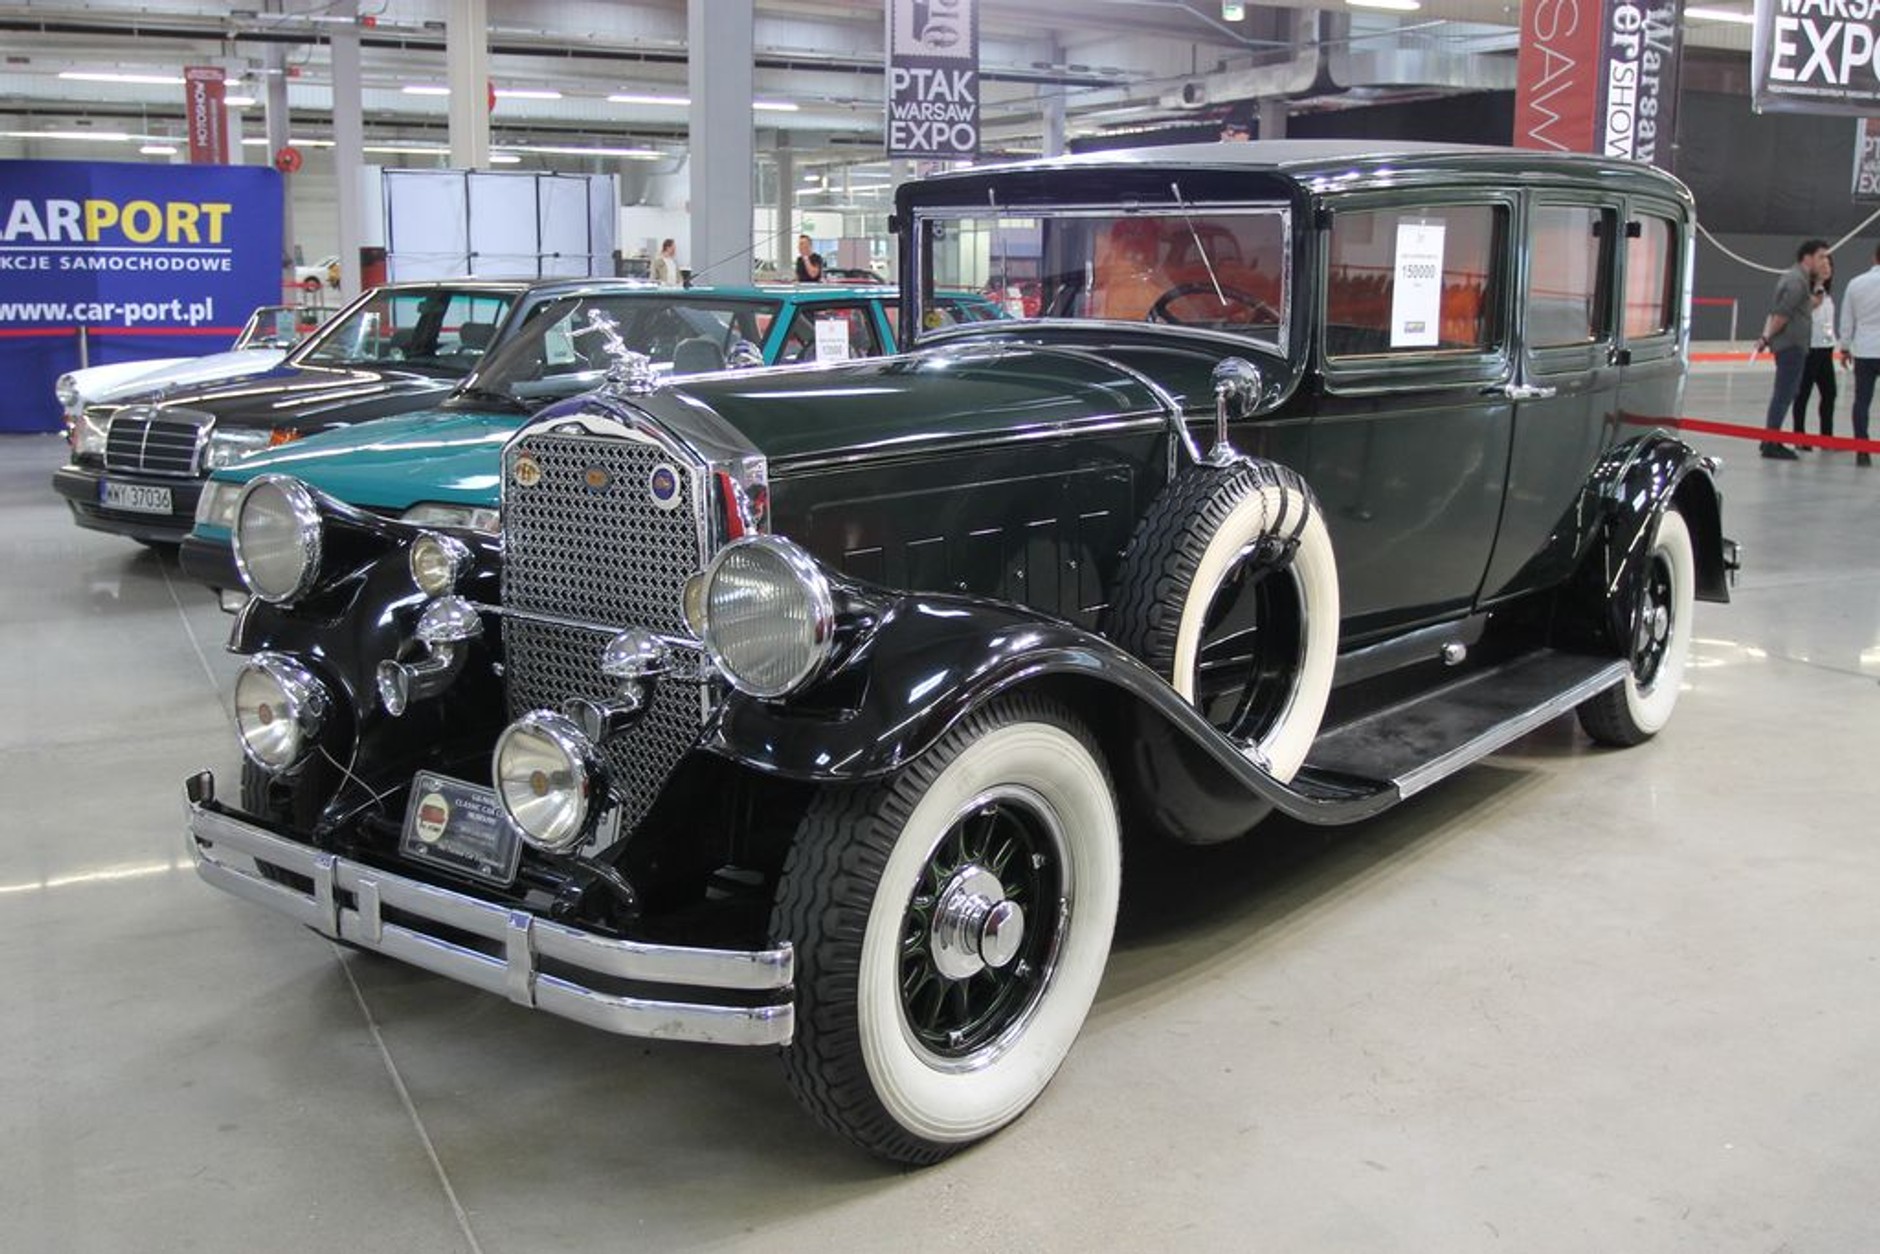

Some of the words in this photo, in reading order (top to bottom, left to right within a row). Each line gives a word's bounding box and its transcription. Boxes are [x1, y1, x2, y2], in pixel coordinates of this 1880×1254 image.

[1610, 0, 1641, 60] er
[1770, 15, 1880, 85] EXP
[890, 67, 975, 103] PTAK
[890, 102, 976, 121] WARSAW
[1608, 65, 1635, 158] SHOW
[890, 121, 976, 151] EXPO
[0, 199, 232, 243] ARPORT
[59, 256, 232, 272] SAMOCHODOWE
[0, 297, 213, 327] www.car-port.pl
